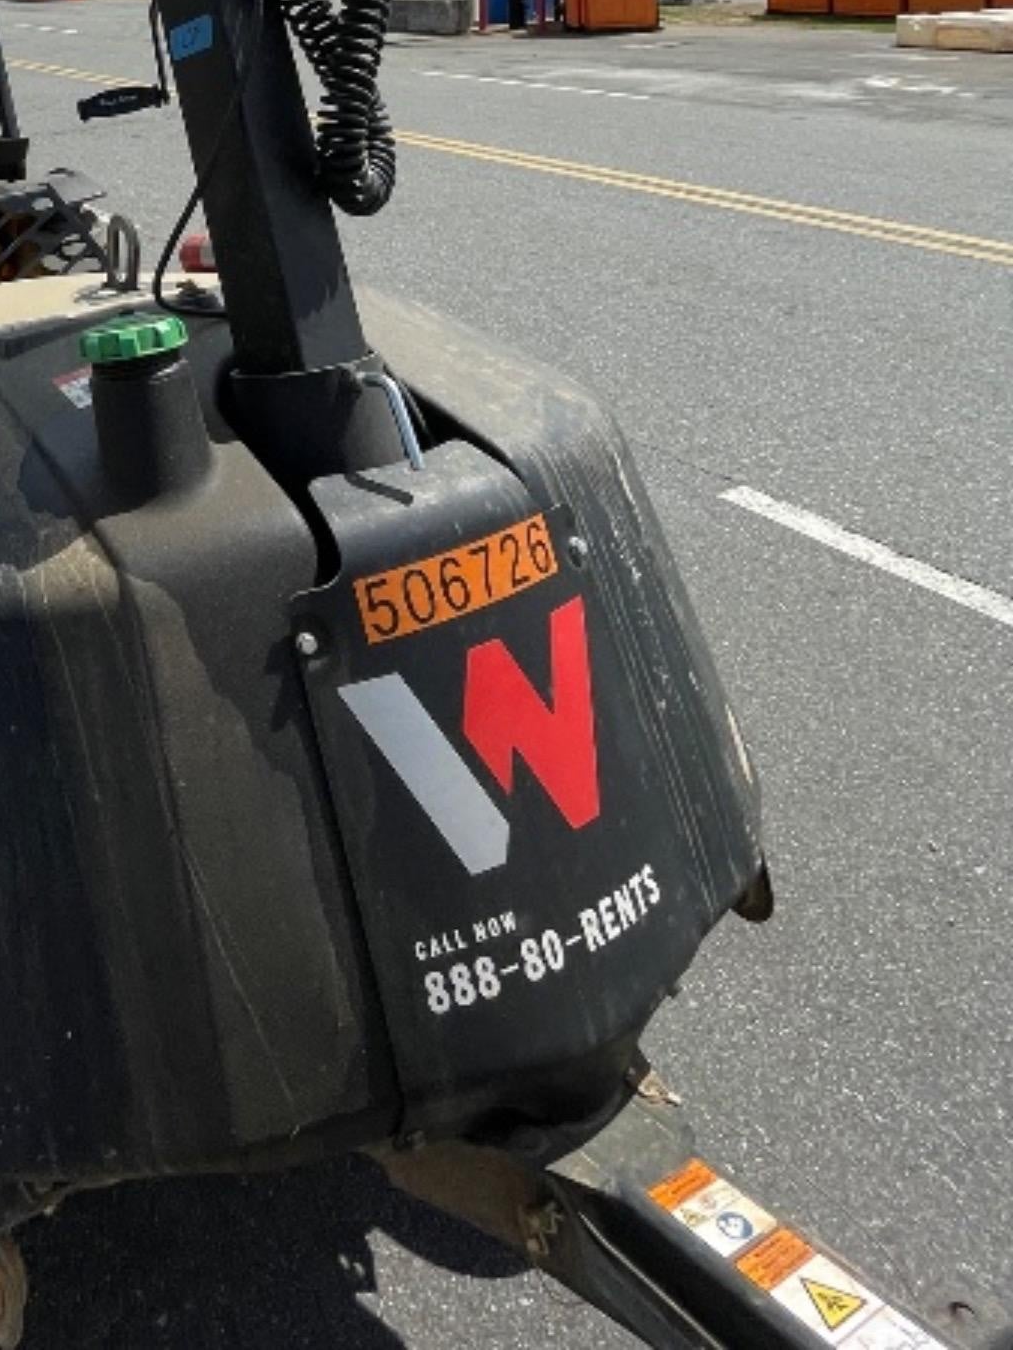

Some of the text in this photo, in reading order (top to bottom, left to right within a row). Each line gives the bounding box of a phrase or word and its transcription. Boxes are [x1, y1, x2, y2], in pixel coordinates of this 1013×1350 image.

[364, 521, 551, 636] 506726
[415, 910, 518, 962] CALL NOW
[423, 863, 661, 1015] 888-80-RENTS
